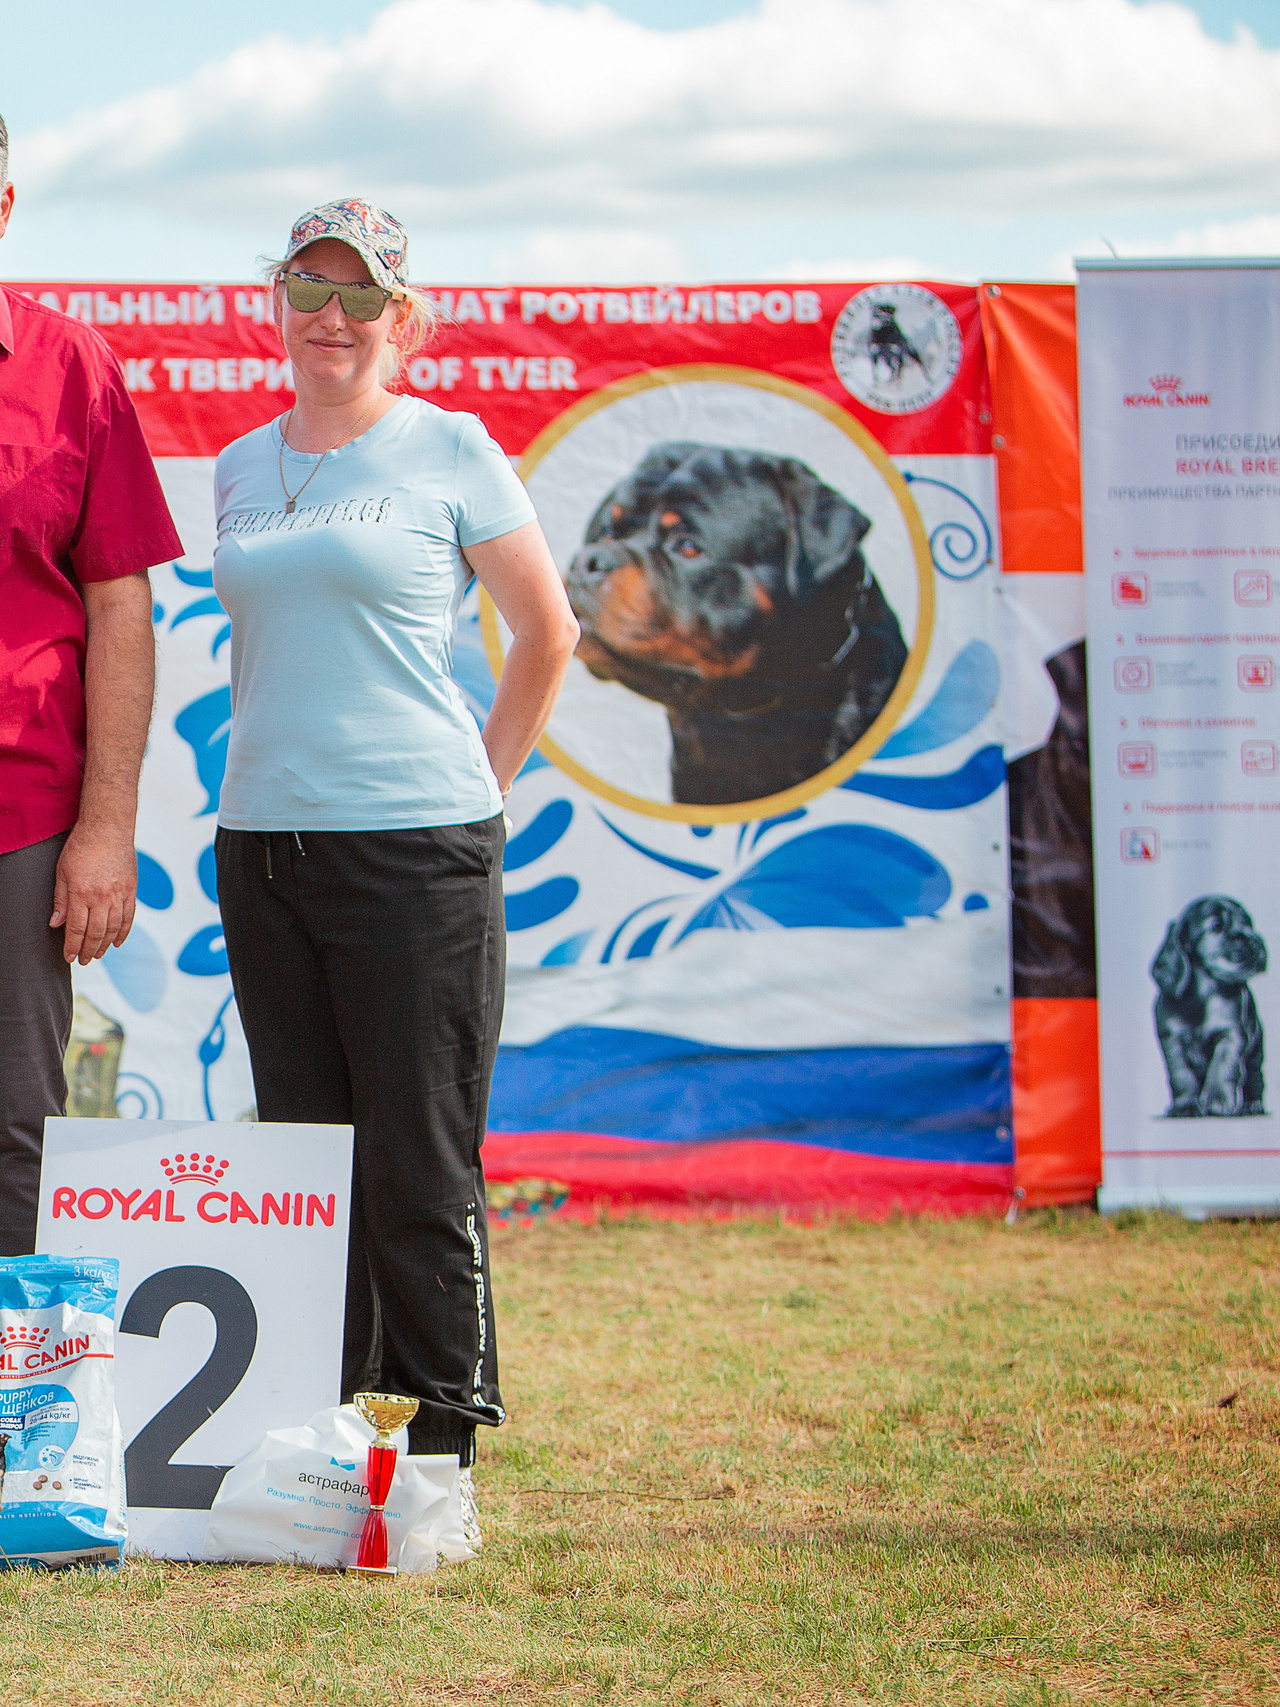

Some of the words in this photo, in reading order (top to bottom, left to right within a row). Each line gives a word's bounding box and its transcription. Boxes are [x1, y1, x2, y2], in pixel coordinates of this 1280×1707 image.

[520, 285, 822, 325] РОТВЕЙЛЕРОВ
[161, 357, 296, 393] ТВЕРИ
[407, 356, 463, 392] OF
[470, 356, 579, 392] TVER
[1175, 457, 1235, 477] ROYAL
[51, 1186, 186, 1224] ROYAL
[197, 1191, 335, 1227] CANIN
[74, 1265, 81, 1278] 3
[24, 1334, 90, 1369] CANIN
[118, 1264, 258, 1510] 2
[1, 1391, 54, 1416] ЩЕНКОВ
[298, 1472, 370, 1497] астрафар
[266, 1487, 307, 1503] Разумно.
[308, 1495, 343, 1510] Просто.
[18, 1511, 57, 1519] NUTRITION
[293, 1521, 364, 1540] www.astrafarm.co
